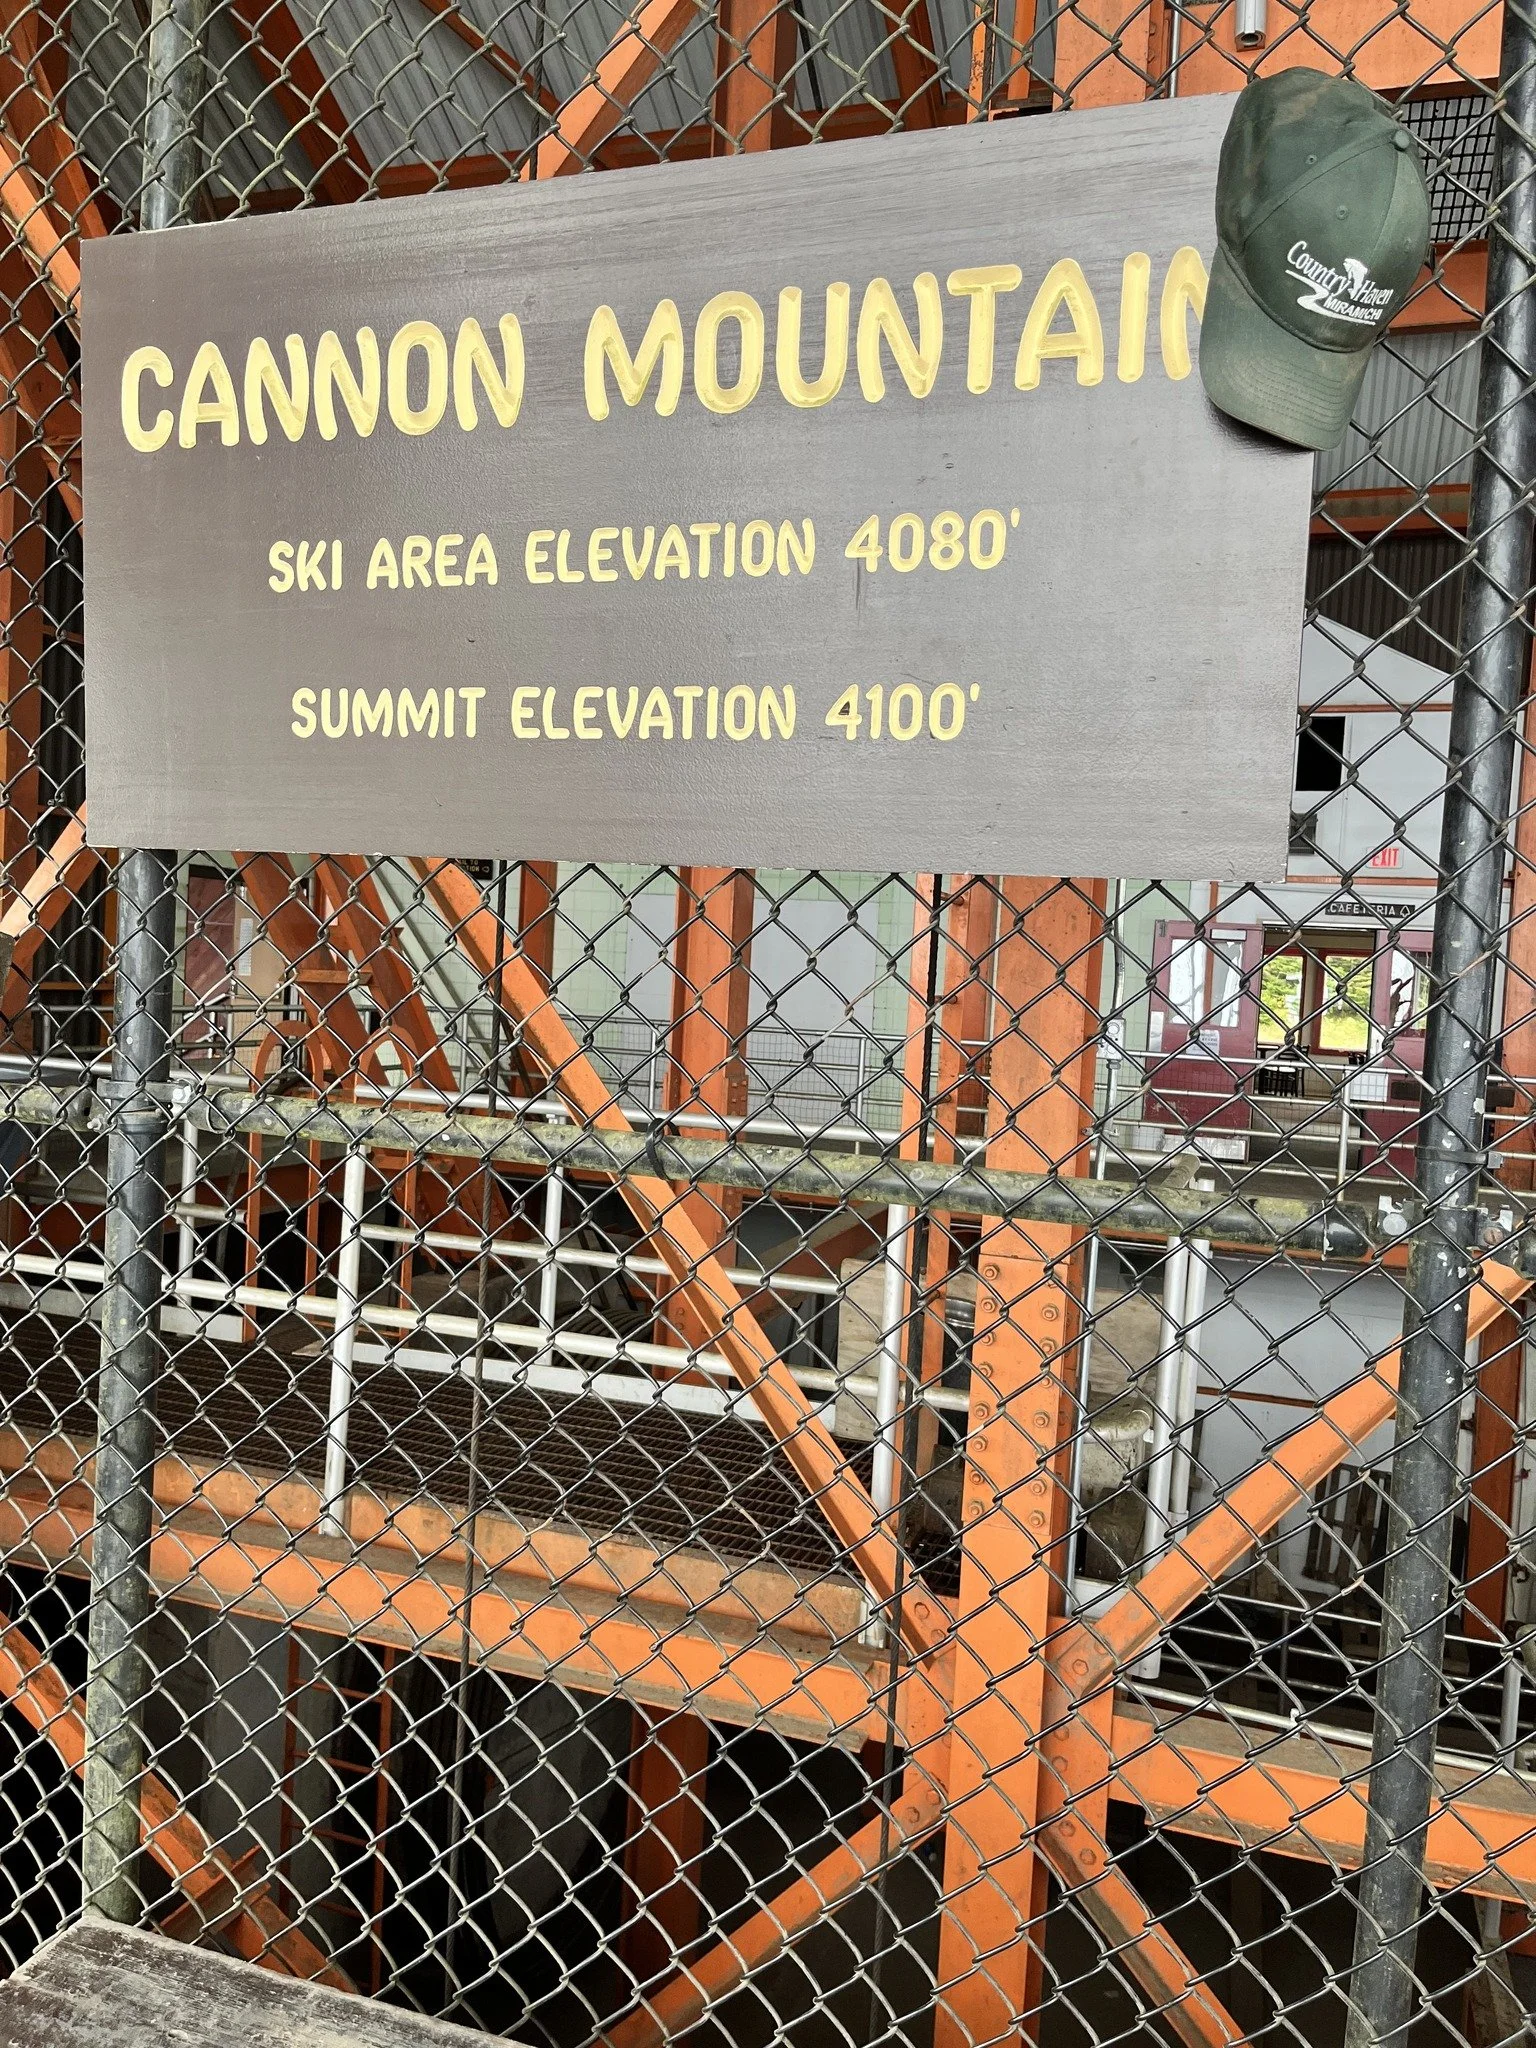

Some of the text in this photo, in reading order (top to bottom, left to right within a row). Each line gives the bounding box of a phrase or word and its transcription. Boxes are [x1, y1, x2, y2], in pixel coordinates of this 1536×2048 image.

[1286, 240, 1394, 306] Country Haven
[1323, 295, 1384, 321] MIRAMICHI
[120, 312, 526, 454] CANNON
[268, 508, 1021, 594] SKI AREA ELEVATION 4080'
[290, 683, 980, 741] SUMMIT ELEVATION 4100'
